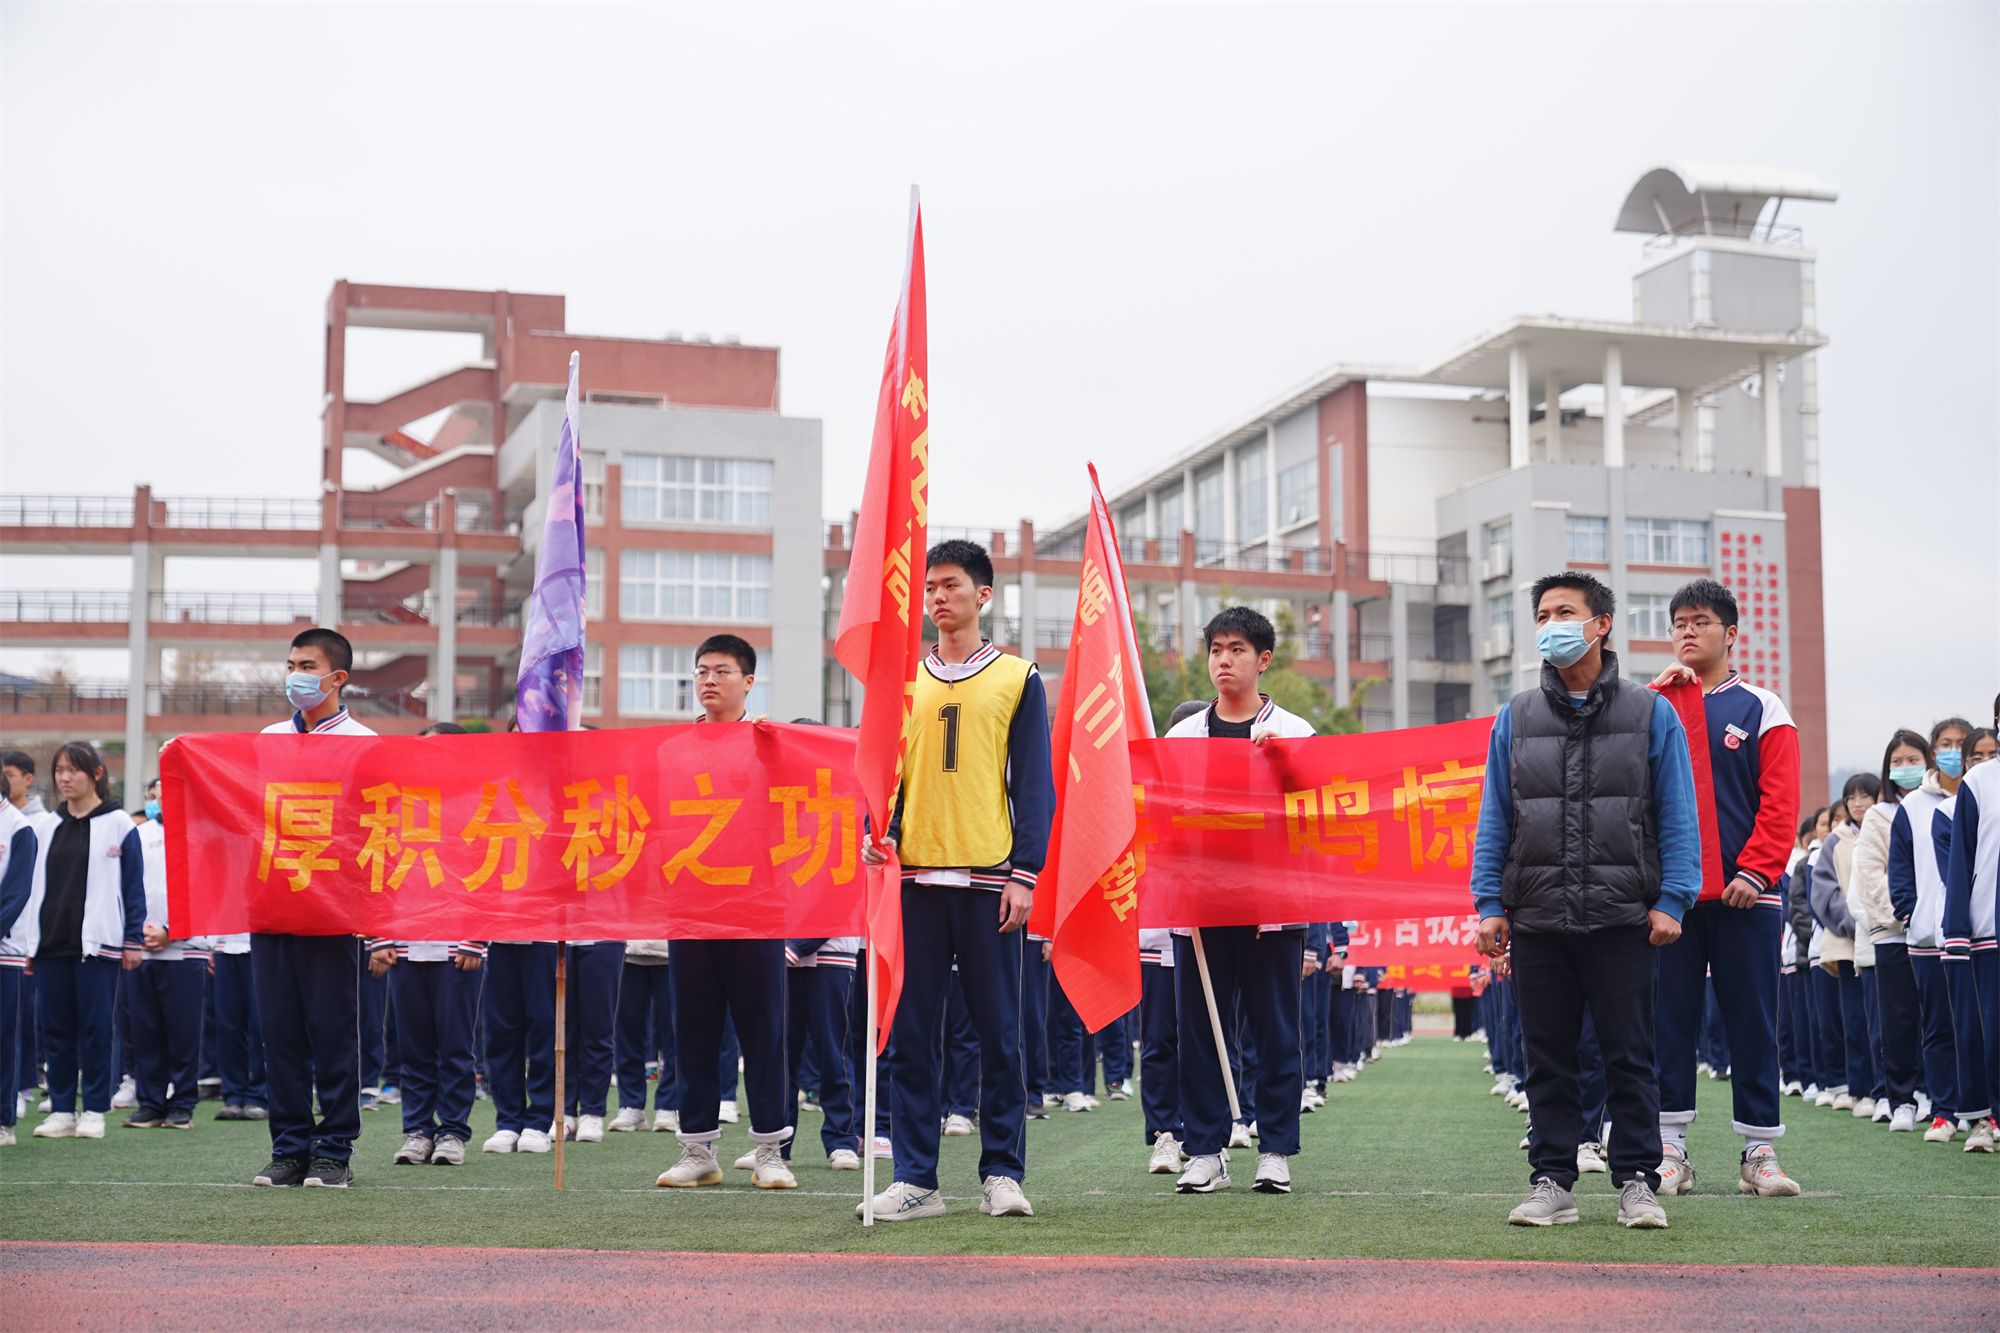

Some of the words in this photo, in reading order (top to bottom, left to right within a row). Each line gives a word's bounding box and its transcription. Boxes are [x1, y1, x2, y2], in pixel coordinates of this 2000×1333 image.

[938, 703, 961, 772] 1
[257, 768, 856, 893] 厚积分秒之功
